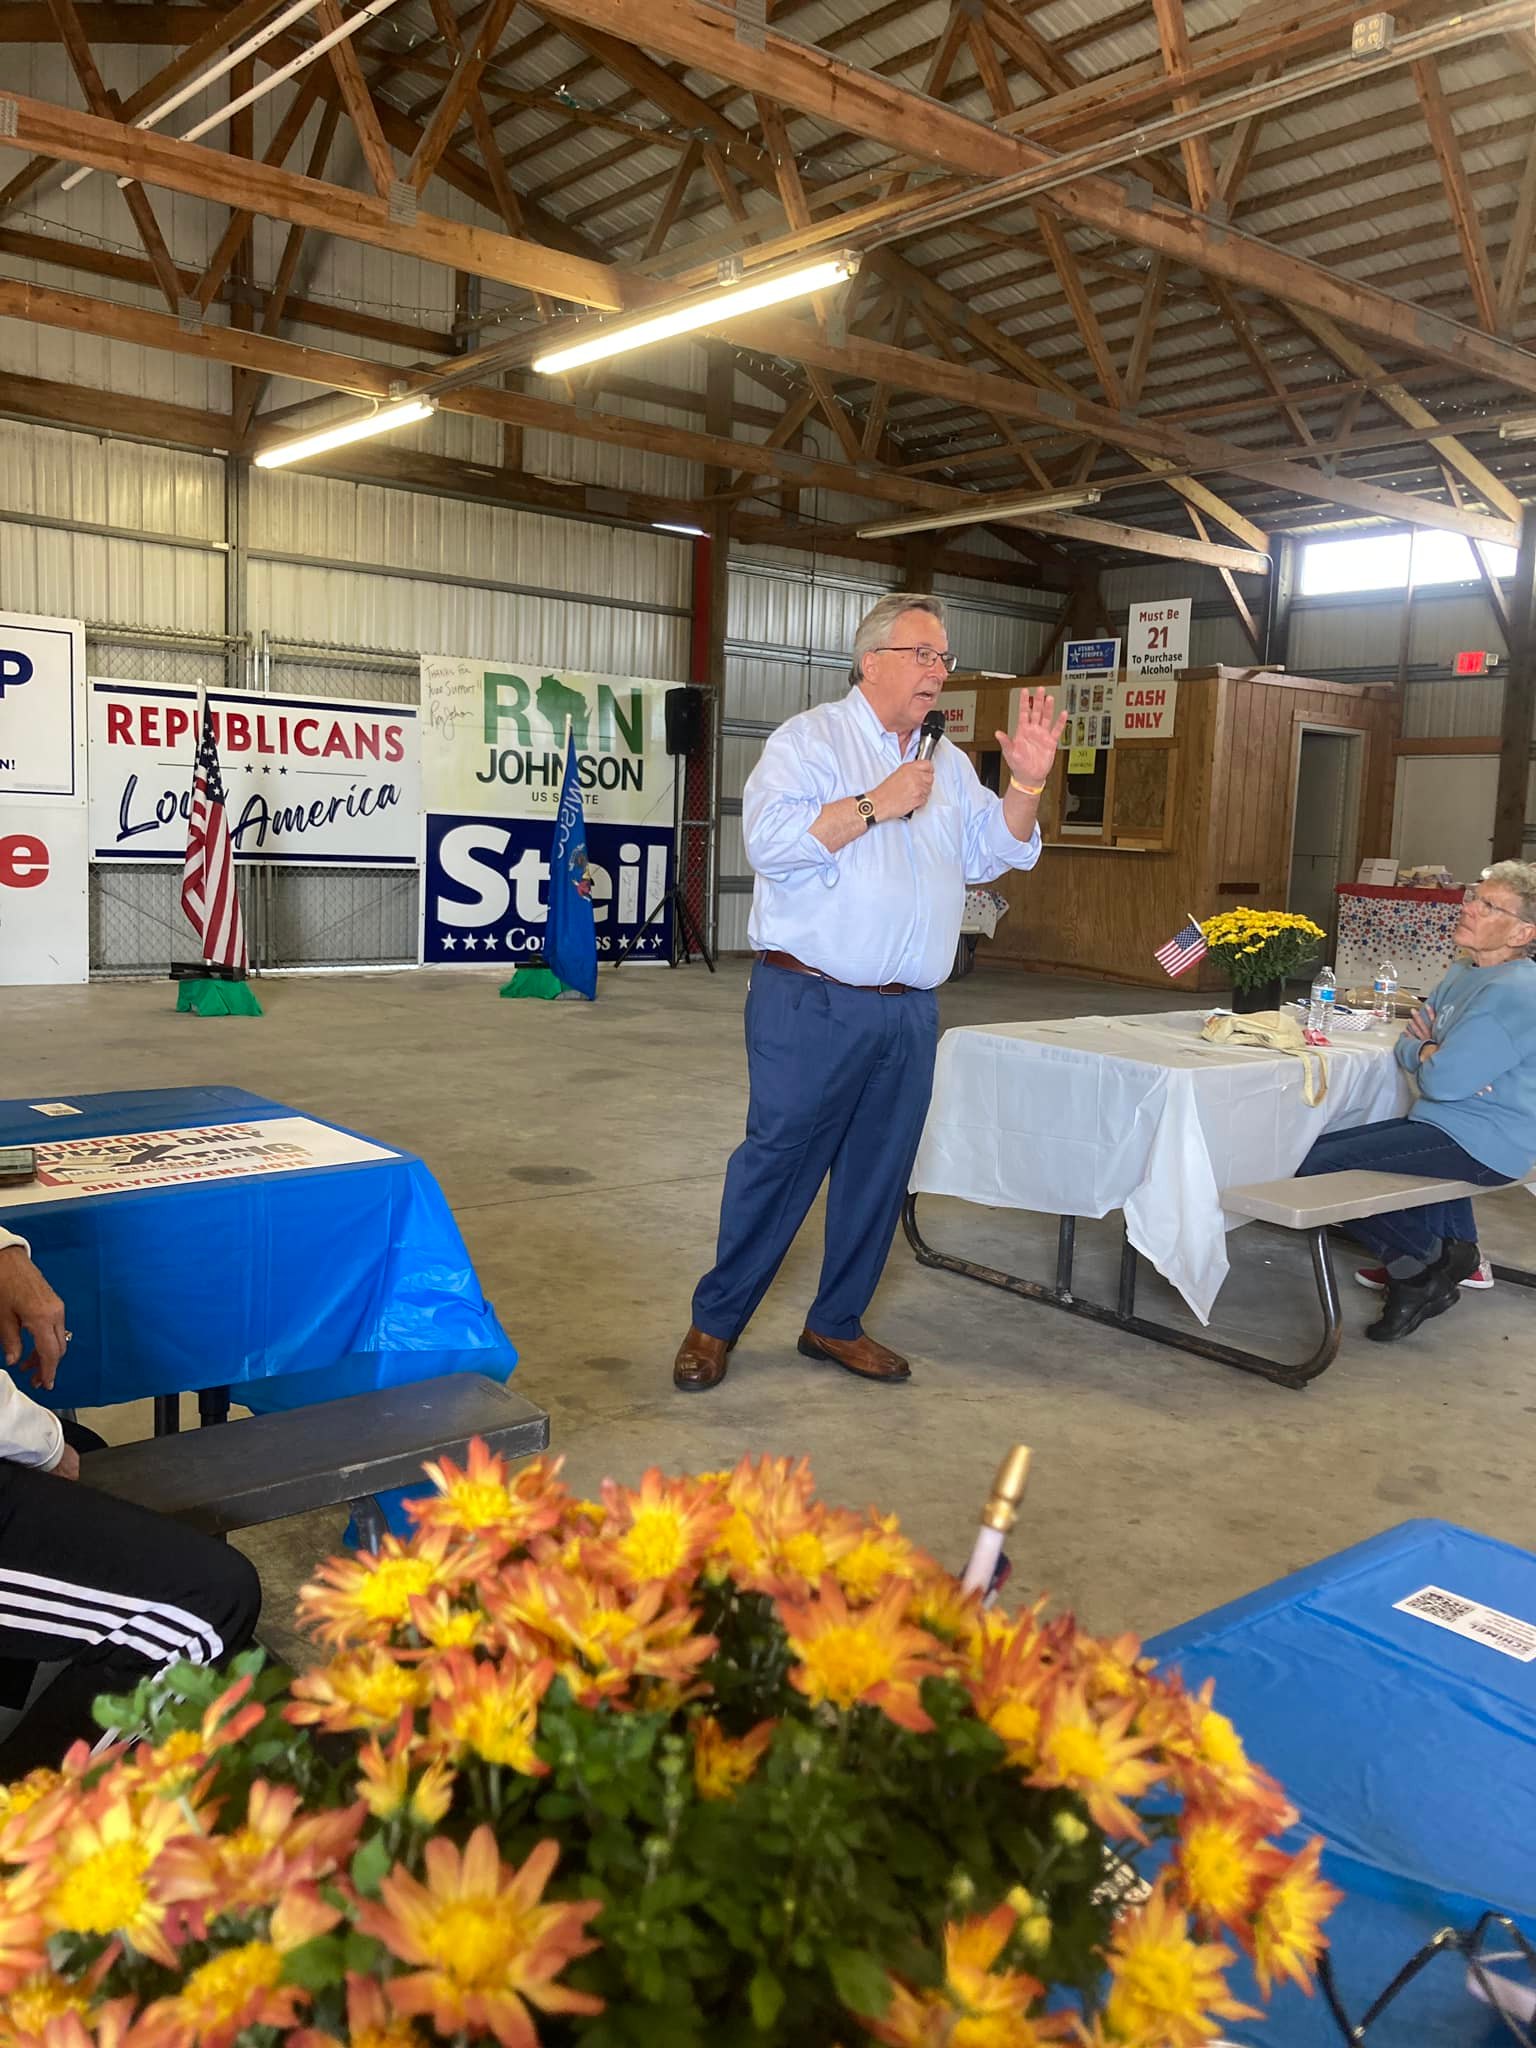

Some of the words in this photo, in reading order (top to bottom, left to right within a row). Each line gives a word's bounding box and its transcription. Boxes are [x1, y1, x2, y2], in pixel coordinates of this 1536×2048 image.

[1139, 610, 1164, 623] Must
[1167, 609, 1180, 620] Be
[1147, 626, 1169, 649] 21
[1132, 654, 1142, 664] To
[1144, 652, 1183, 664] Purchase
[1140, 663, 1173, 676] Alcohol
[1125, 689, 1166, 707] CASH
[942, 709, 964, 721] ASH
[1124, 711, 1164, 729] ONLY
[107, 703, 405, 763] REPUBLICANS
[531, 791, 548, 803] US
[230, 782, 402, 850] America
[36, 1131, 179, 1153] UPPORT
[189, 1124, 256, 1136] THE
[36, 1142, 149, 1161] ITIZEN
[175, 1130, 265, 1146] ONLY
[81, 1160, 313, 1192] ONLYCITIZENS.VOTE
[1469, 1621, 1530, 1652] SCHIMEL
